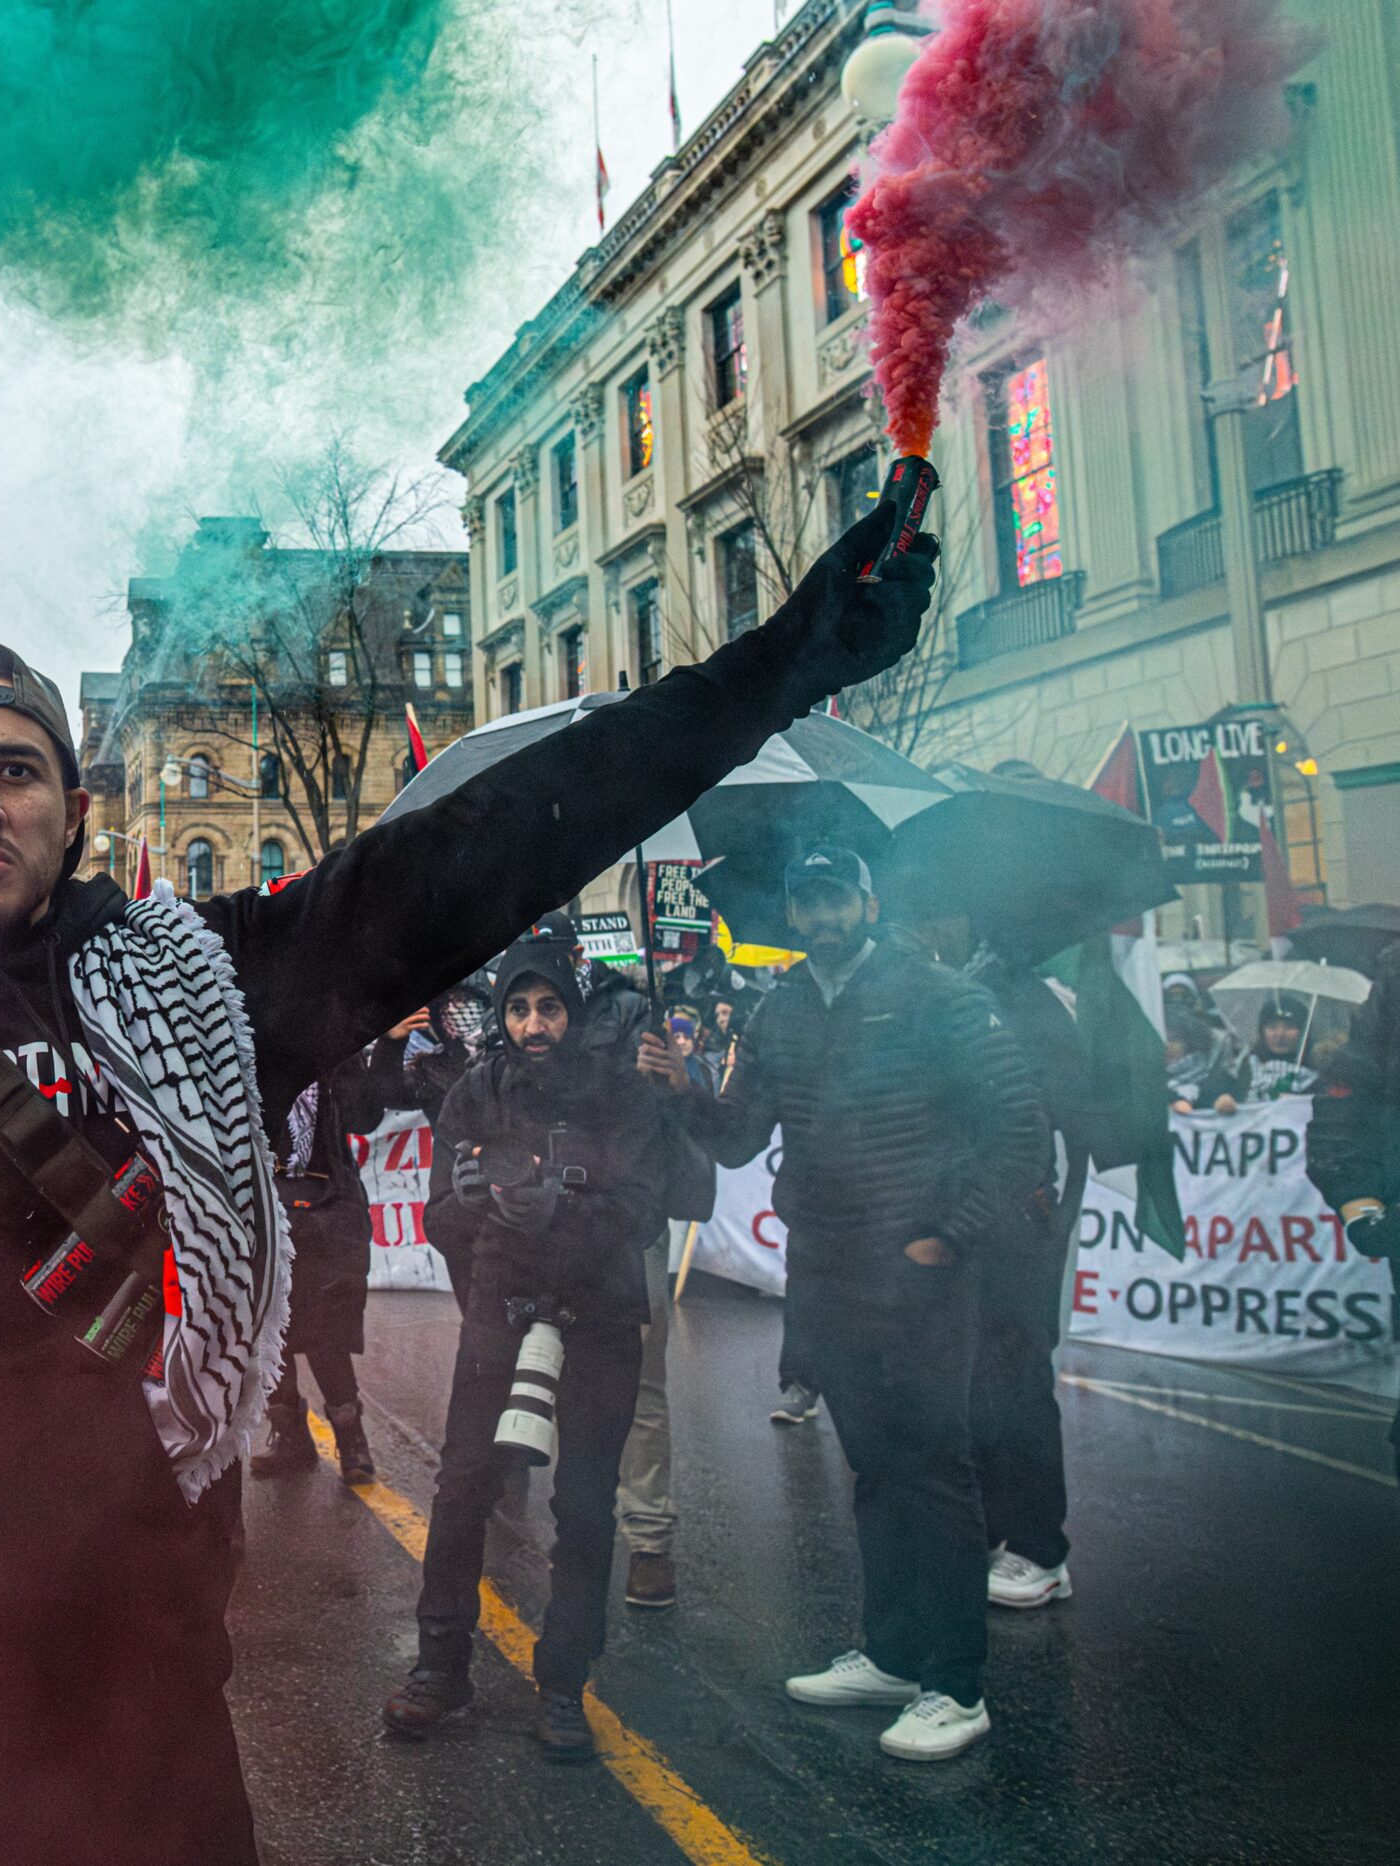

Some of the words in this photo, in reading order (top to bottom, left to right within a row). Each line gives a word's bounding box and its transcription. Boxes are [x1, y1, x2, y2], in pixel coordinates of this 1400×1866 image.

[1151, 732, 1210, 764] LONG
[1216, 721, 1264, 758] LIVE
[658, 864, 687, 878] FREE
[657, 890, 685, 905] FREE
[666, 905, 696, 919] LAND
[582, 916, 628, 931] STAND
[1183, 1215, 1347, 1263] APART
[37, 1262, 72, 1305] WIRE
[1126, 1277, 1399, 1341] OPPRESS
